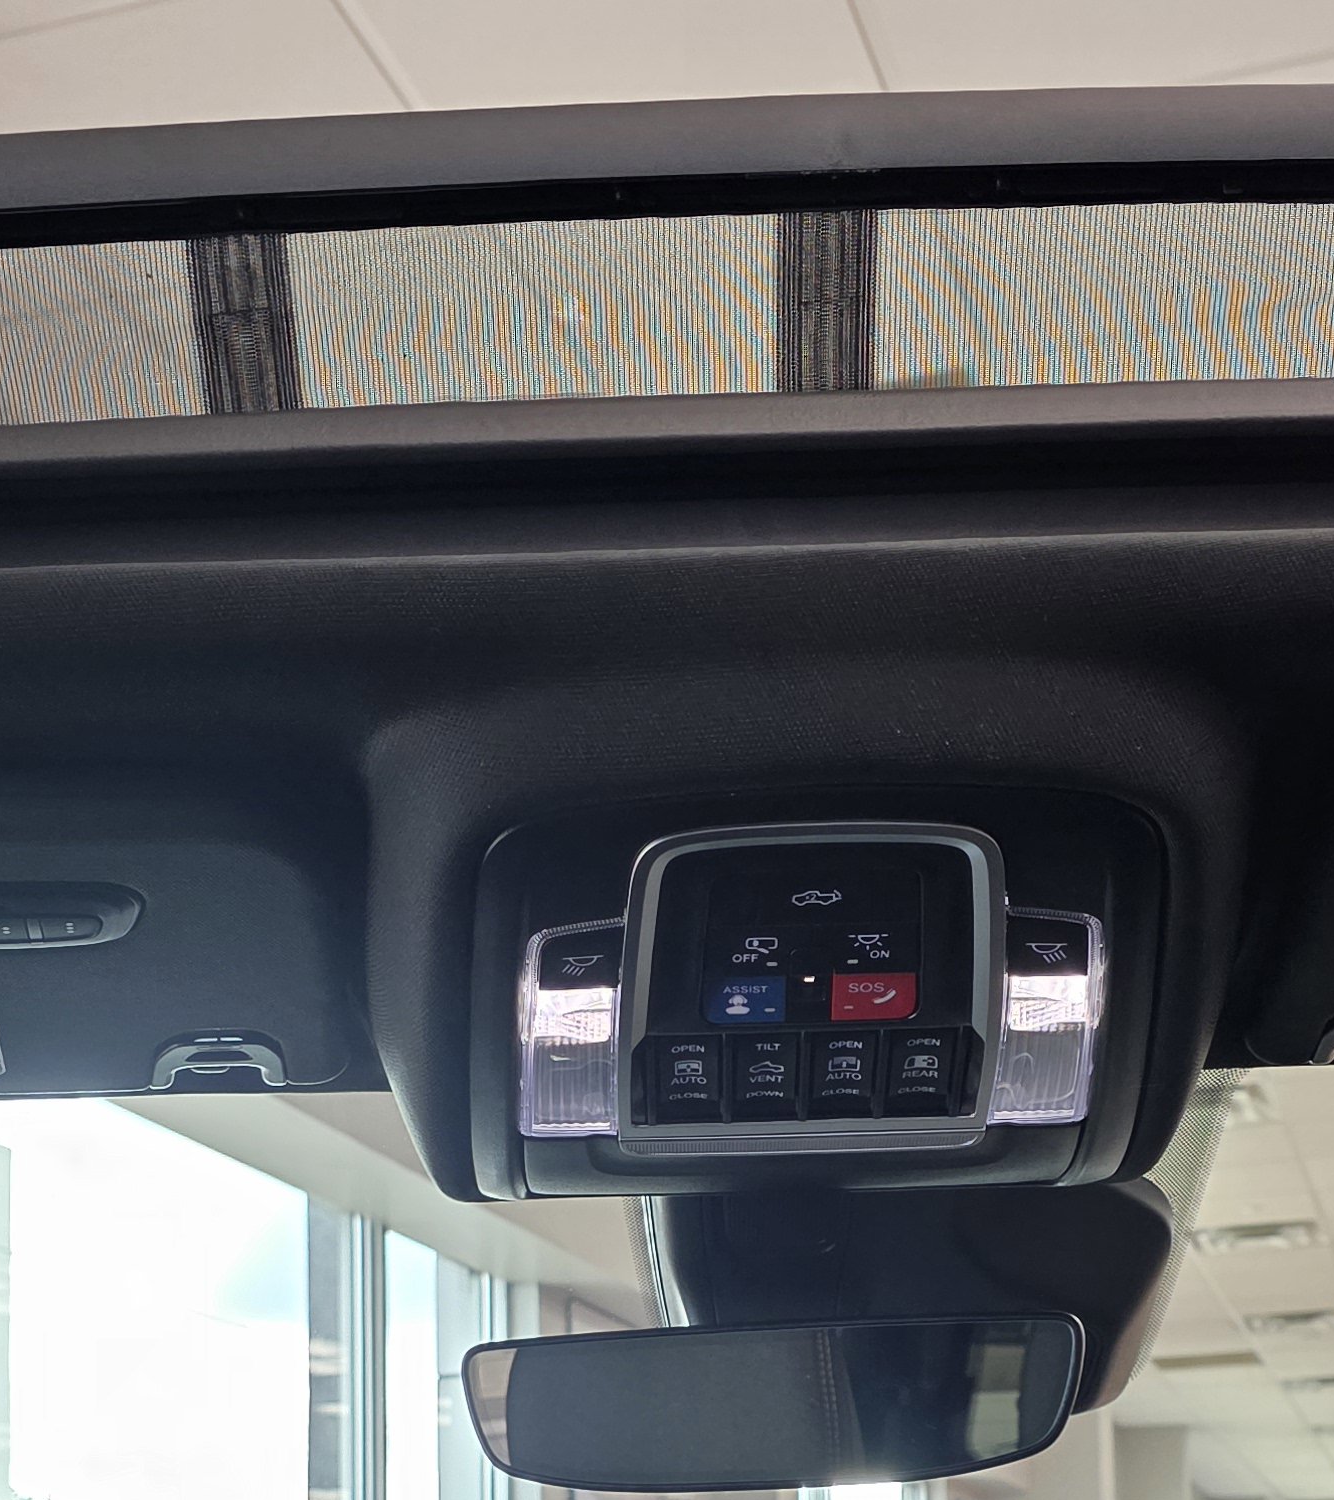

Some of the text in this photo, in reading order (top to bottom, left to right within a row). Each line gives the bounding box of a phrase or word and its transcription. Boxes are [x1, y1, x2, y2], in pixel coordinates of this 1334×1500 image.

[731, 953, 760, 963] OFF
[870, 949, 891, 959] ON
[723, 985, 768, 994] ASSIST
[848, 982, 885, 993] SOS
[756, 1043, 781, 1051] TILT
[828, 1040, 863, 1049] OPEN
[906, 1038, 941, 1047] OPEN
[671, 1044, 705, 1053] OPEN
[749, 1074, 784, 1083] VENT
[825, 1072, 862, 1081] AUTO
[902, 1070, 938, 1079] REAR
[670, 1075, 707, 1085] AUTO
[746, 1089, 784, 1098] DOWN
[821, 1087, 860, 1096] CLOSE
[897, 1085, 937, 1094] CLOSE
[669, 1091, 708, 1100] CLOSE
